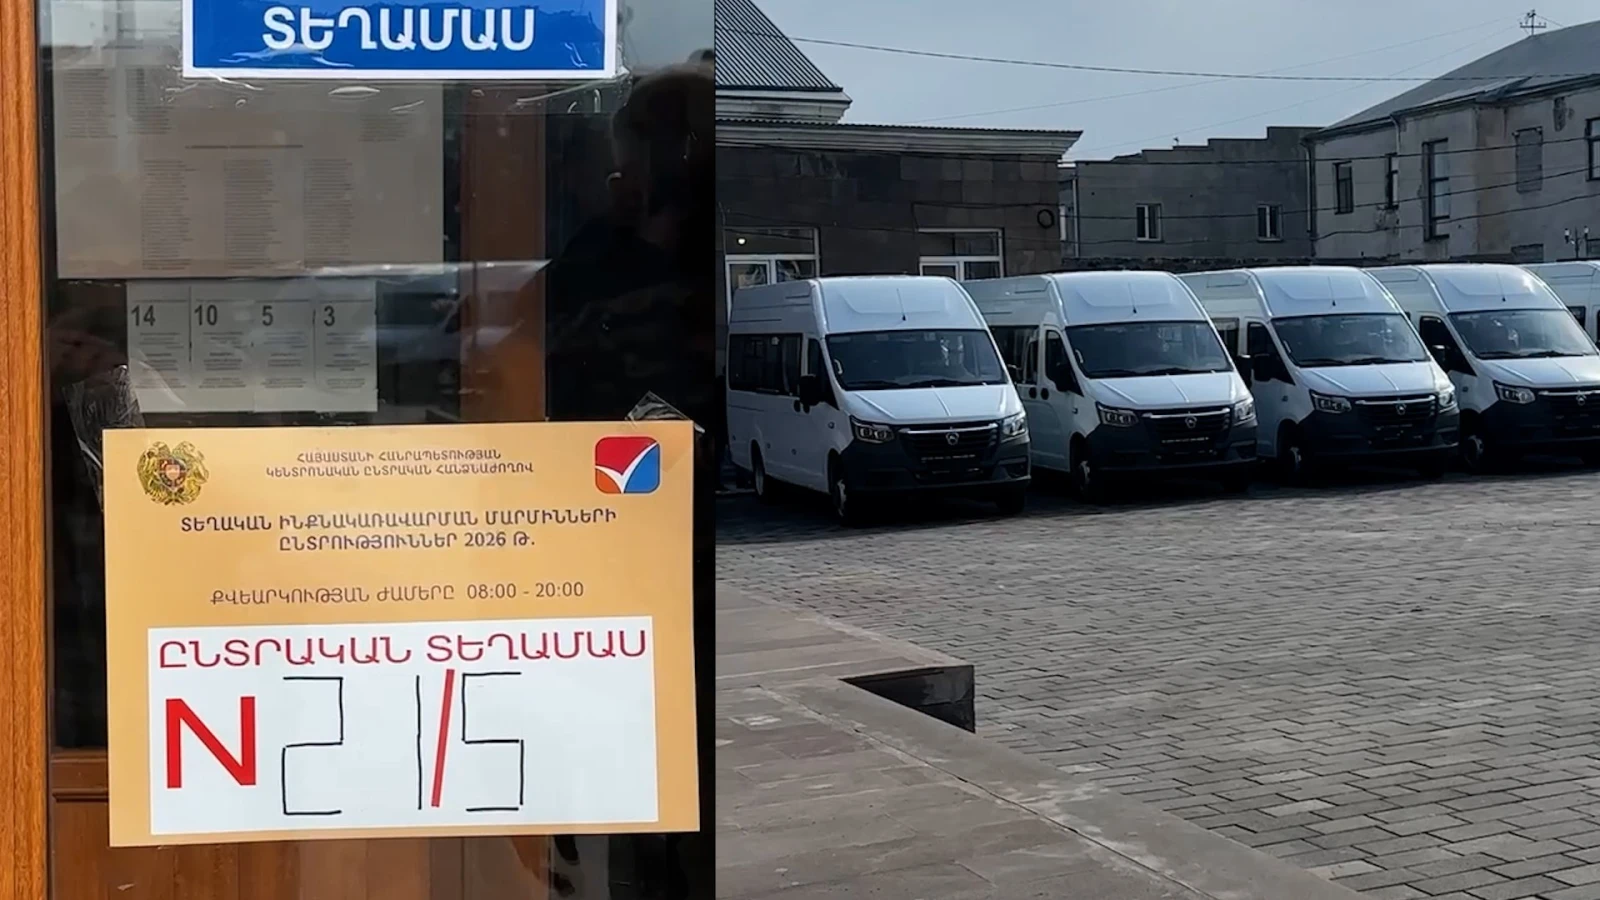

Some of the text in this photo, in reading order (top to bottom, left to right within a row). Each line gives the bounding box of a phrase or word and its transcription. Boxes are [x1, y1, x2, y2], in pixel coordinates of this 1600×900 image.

[261, 5, 536, 52] ՏԵՂԱՄԱՍ
[130, 303, 157, 328] 14
[193, 303, 219, 327] 10
[261, 304, 274, 327] 5
[323, 304, 336, 327] 3
[296, 449, 501, 463] ՀԱՅԱՍՏԱՆԻ ՀԱՆՐԱՊԵՏՈՒԹՅԱՆ
[266, 462, 534, 478] ԿԵՆՏՐՈՆԱԿԱՆ ԸՆՏՐԱԿԱՆ ՀԱՆՁՆԱԺՈՂՈՎ
[181, 508, 617, 532] ՏԵՂԱԿԱՆ ԻՆՔՆԱԿԱՌԱՎԱՐՄԱՆ ՄԱՐՄԻՆՆԵՐԻ
[279, 531, 536, 551] ԸՆՏՐՈՒԹՅՈՒՆՆԵՐ 2026 Թ.
[210, 588, 370, 605] ՔՎԵԱՐԿՈՒԹՅԱՆ
[376, 585, 455, 601] ԺԱՄԵՐԸ
[467, 583, 517, 600] 08:00
[535, 582, 584, 598] 20:00
[159, 629, 646, 668] ԸՆՏՐԱԿԱՆ ՏԵՂԱՄԱՍ
[165, 696, 256, 789] N
